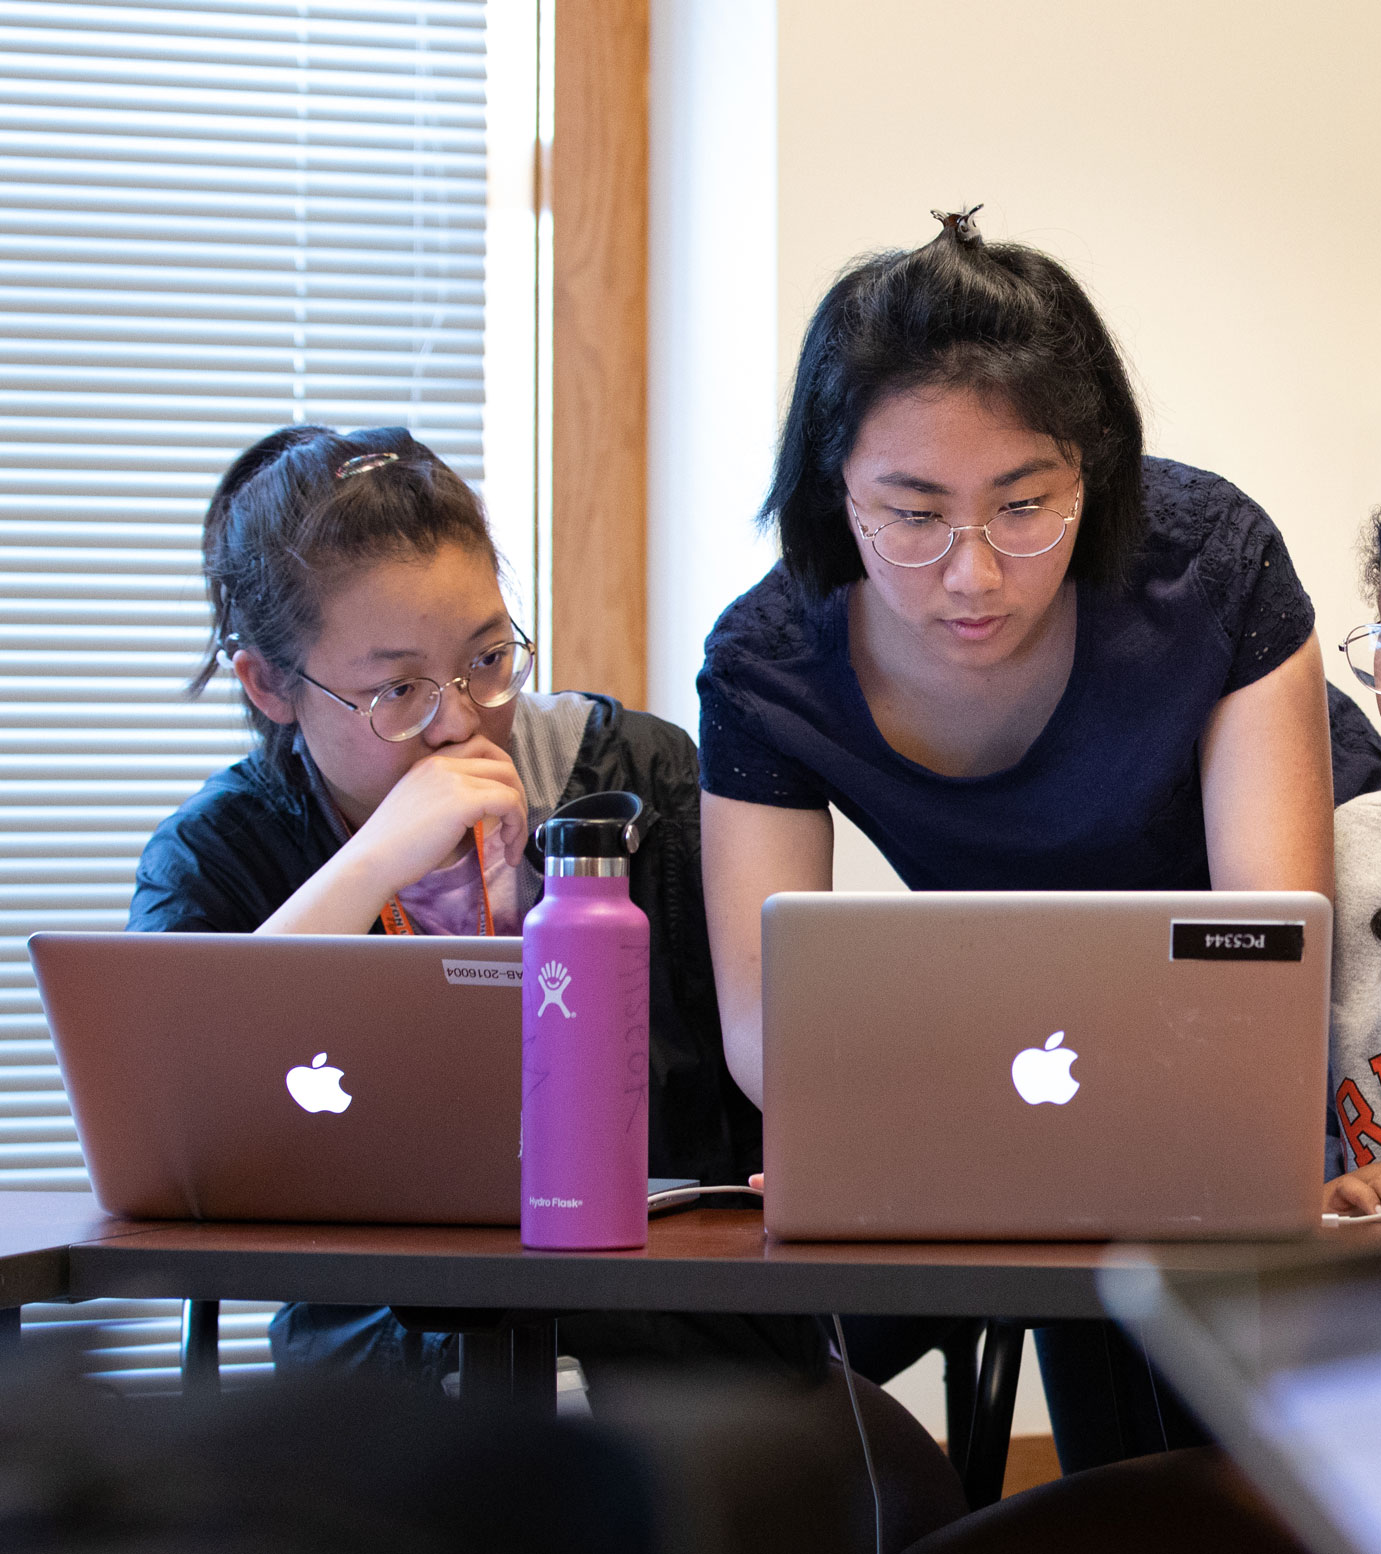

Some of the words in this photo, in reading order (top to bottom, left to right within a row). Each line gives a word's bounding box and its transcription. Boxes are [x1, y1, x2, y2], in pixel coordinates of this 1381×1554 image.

[1204, 933, 1266, 949] PC5344
[447, 967, 523, 980] AB-2016004
[529, 1196, 551, 1209] Hydro
